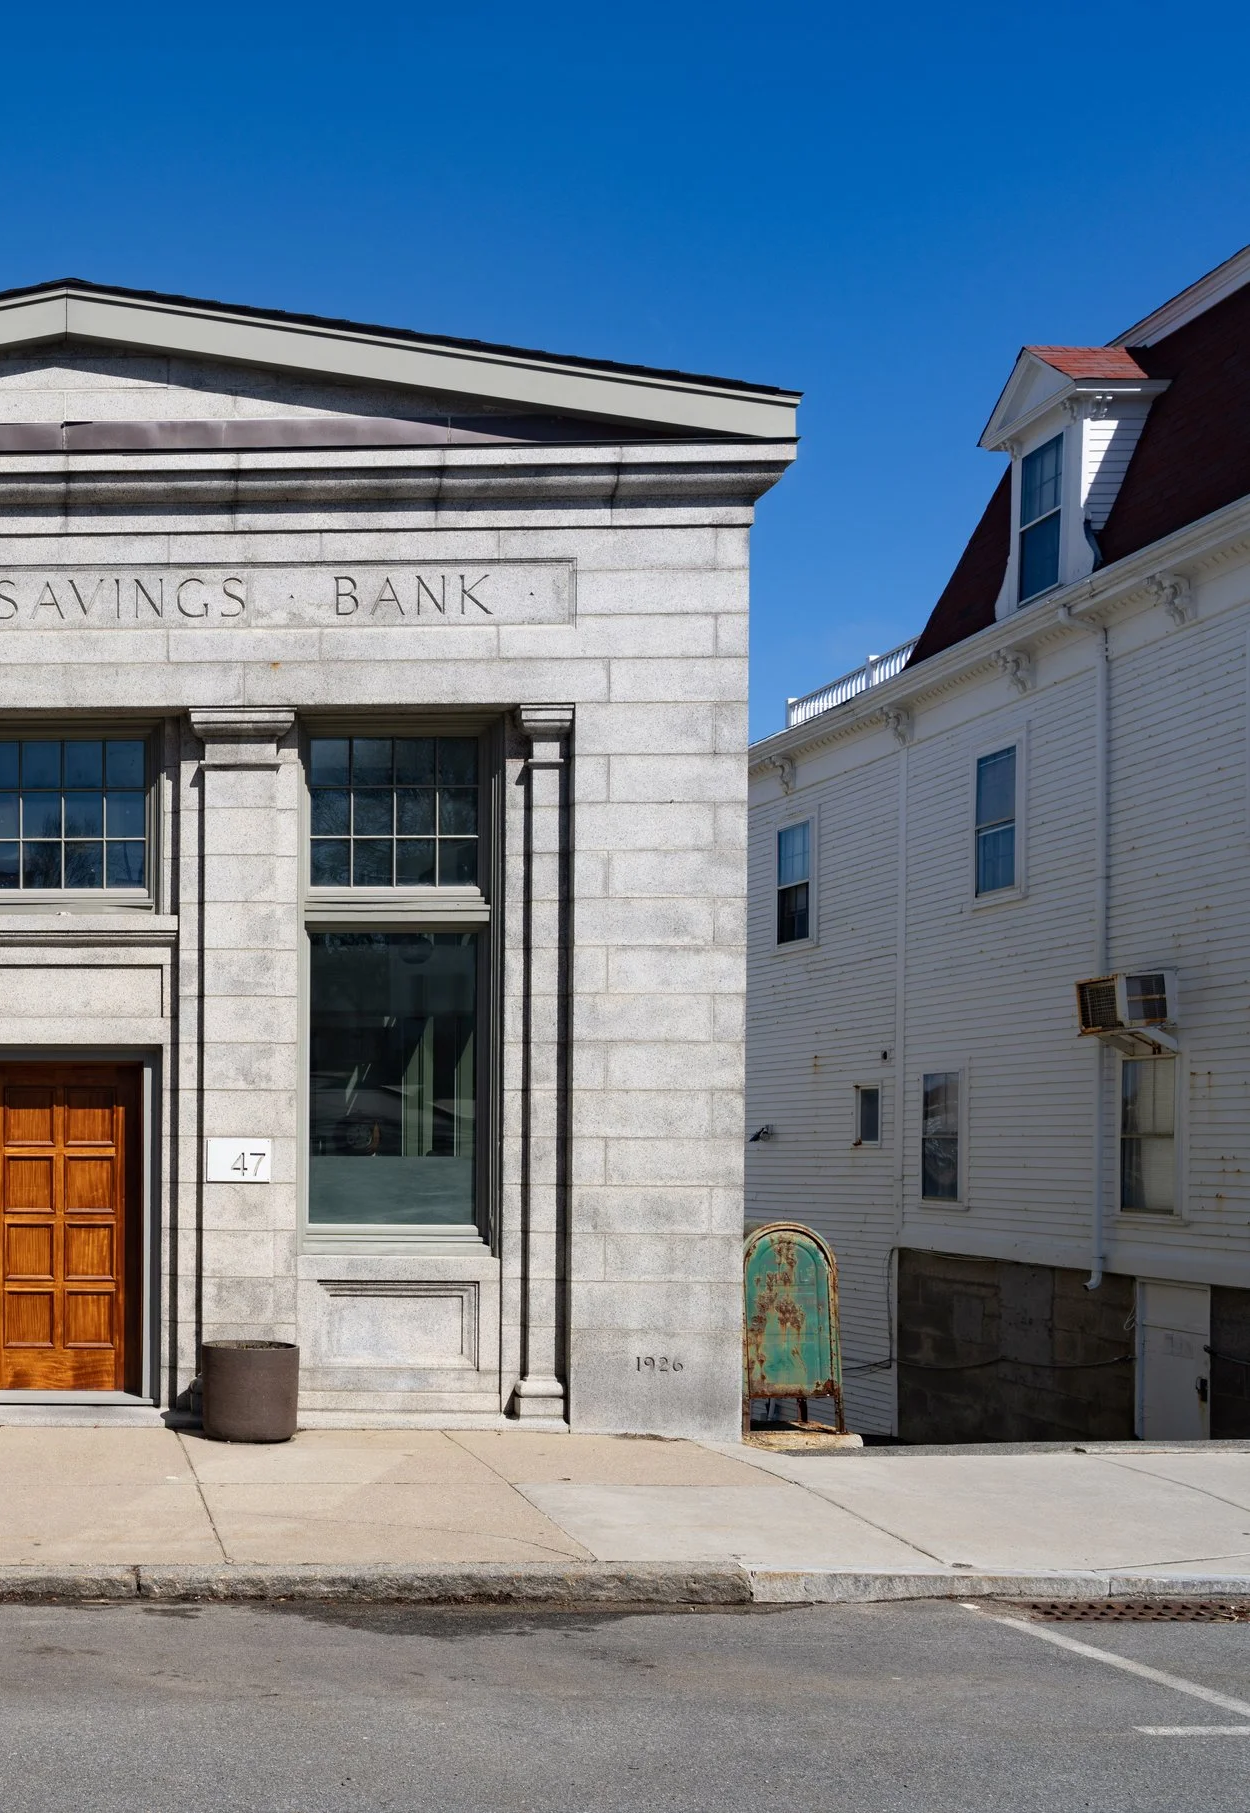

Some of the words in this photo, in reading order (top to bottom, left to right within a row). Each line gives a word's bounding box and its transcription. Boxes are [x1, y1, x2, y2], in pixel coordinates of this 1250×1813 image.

[333, 573, 493, 616] BANK
[230, 1152, 266, 1177] 47
[635, 1355, 684, 1373] 1926
